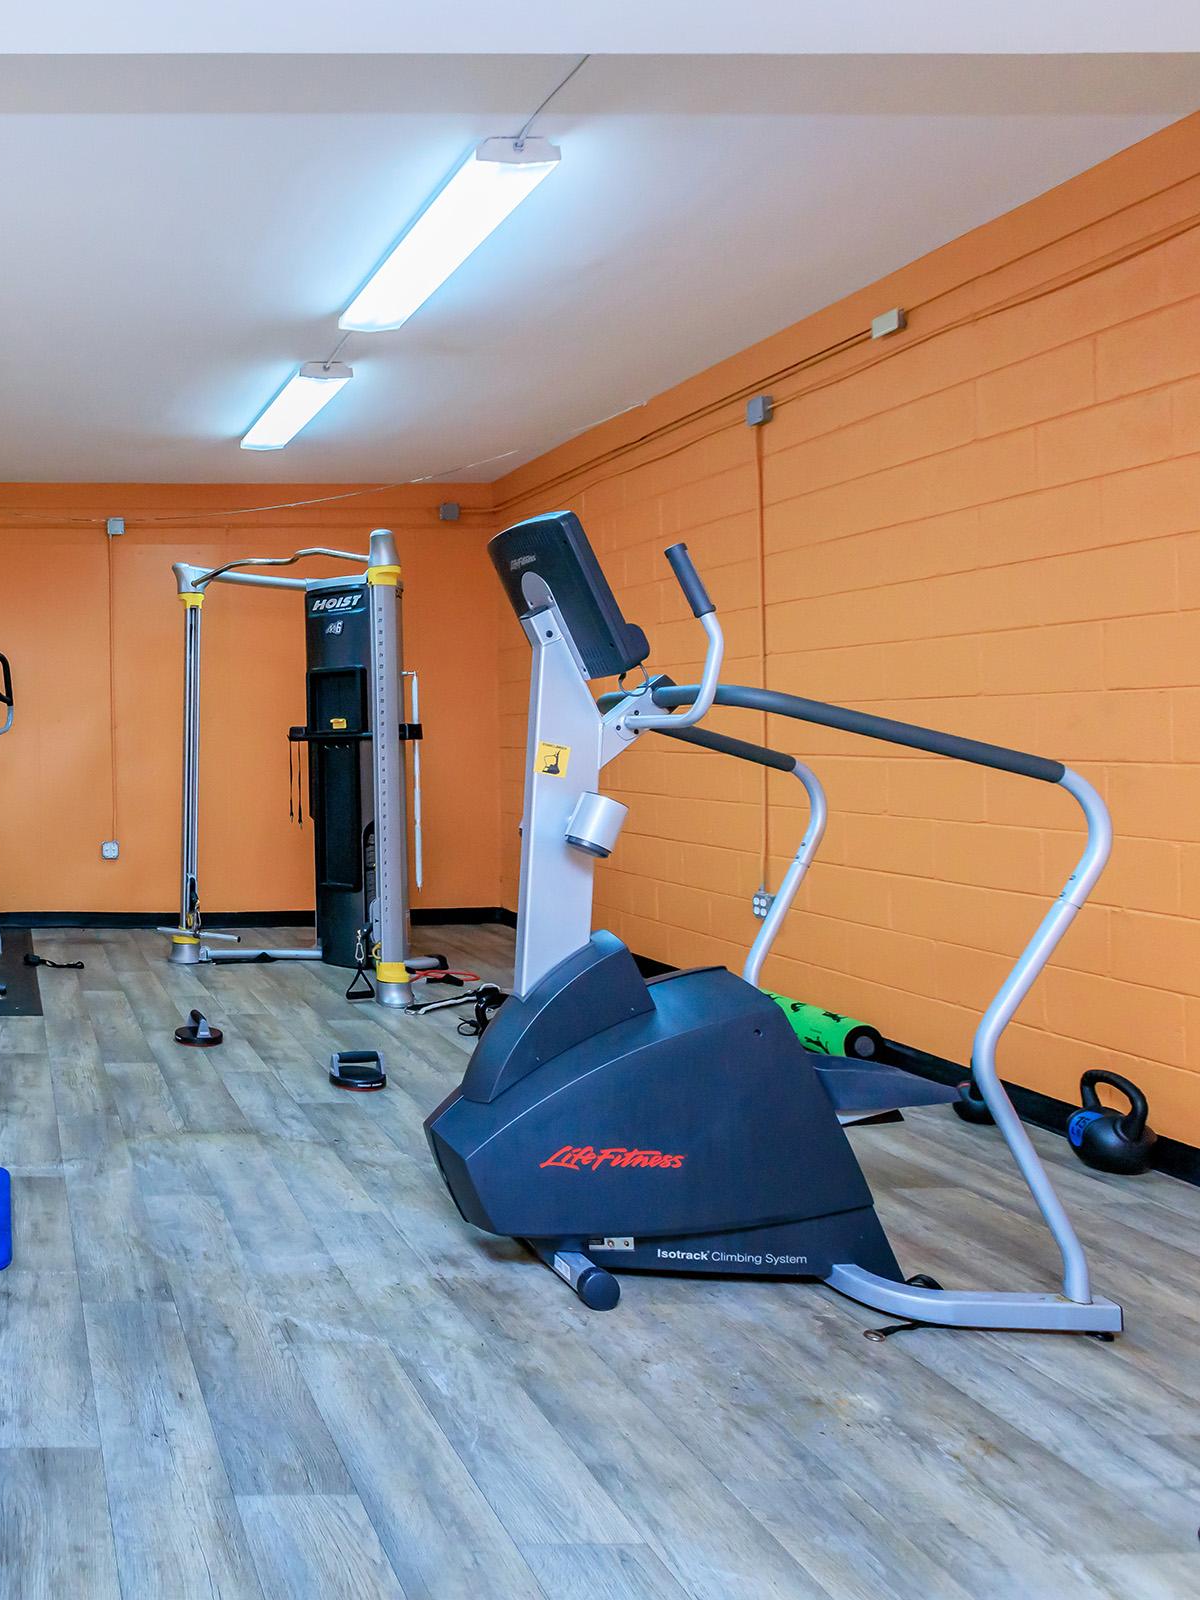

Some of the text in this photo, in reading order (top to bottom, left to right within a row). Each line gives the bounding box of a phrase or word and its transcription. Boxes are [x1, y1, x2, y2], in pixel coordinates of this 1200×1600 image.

[312, 594, 362, 611] HOIST
[711, 1251, 762, 1266] Climbing
[765, 1253, 808, 1266] System
